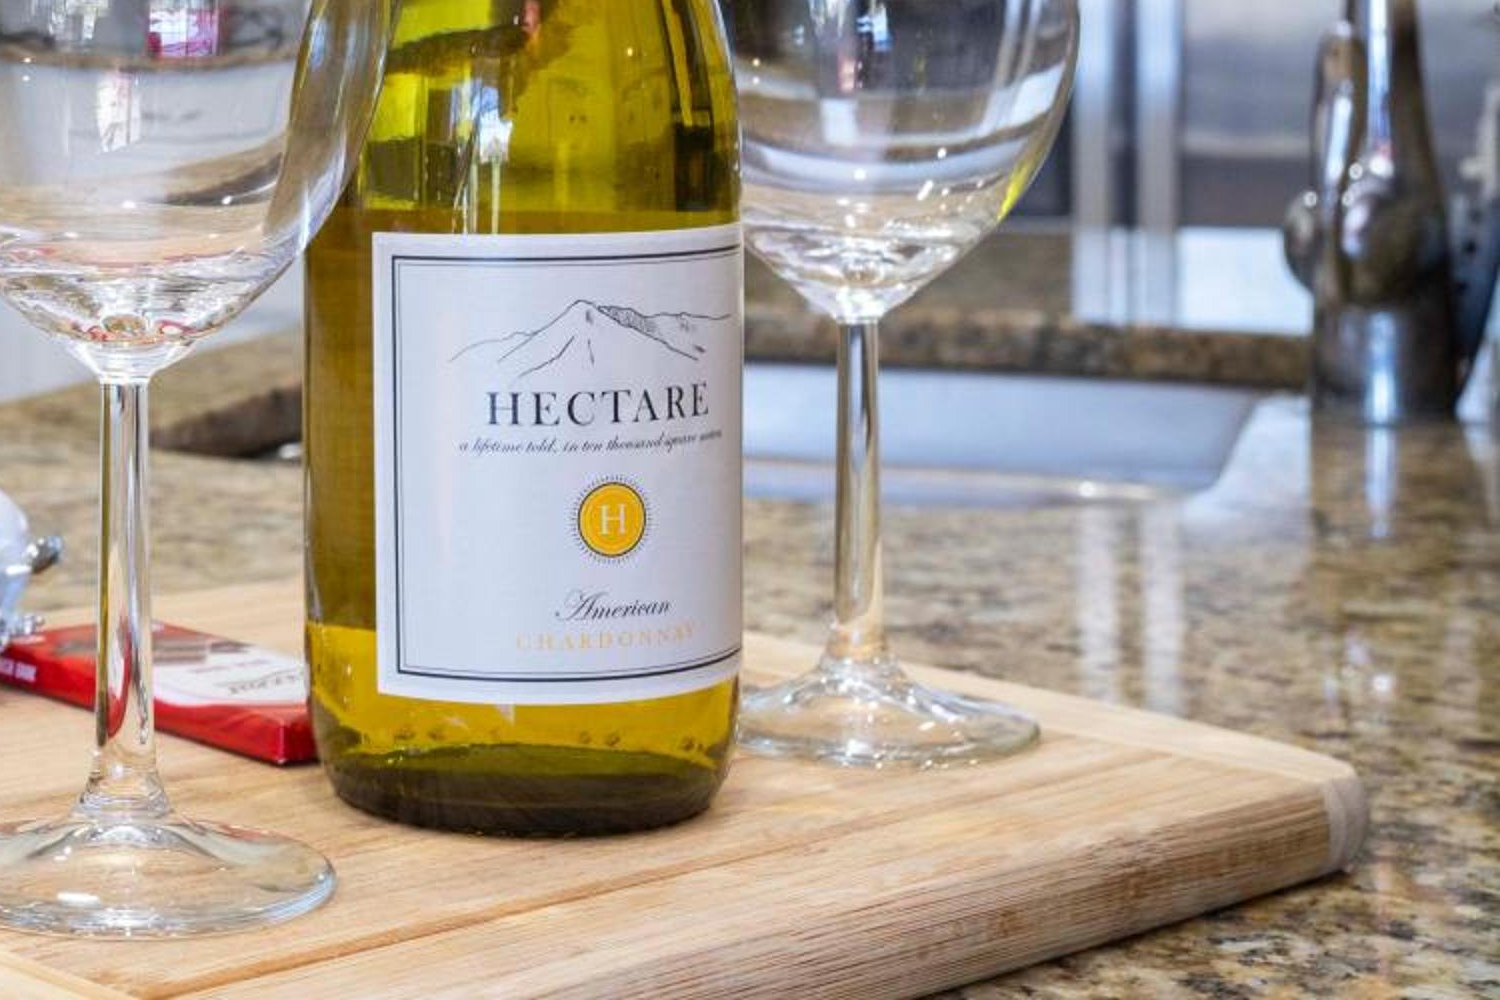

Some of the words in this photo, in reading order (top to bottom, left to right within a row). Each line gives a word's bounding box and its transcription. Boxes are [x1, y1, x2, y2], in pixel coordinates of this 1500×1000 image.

[486, 381, 710, 426] HECTARE
[473, 436, 521, 456] lifetime
[582, 440, 604, 453] ten
[600, 503, 627, 536] H
[555, 590, 675, 621] American
[516, 622, 695, 649] CHARDONNAY
